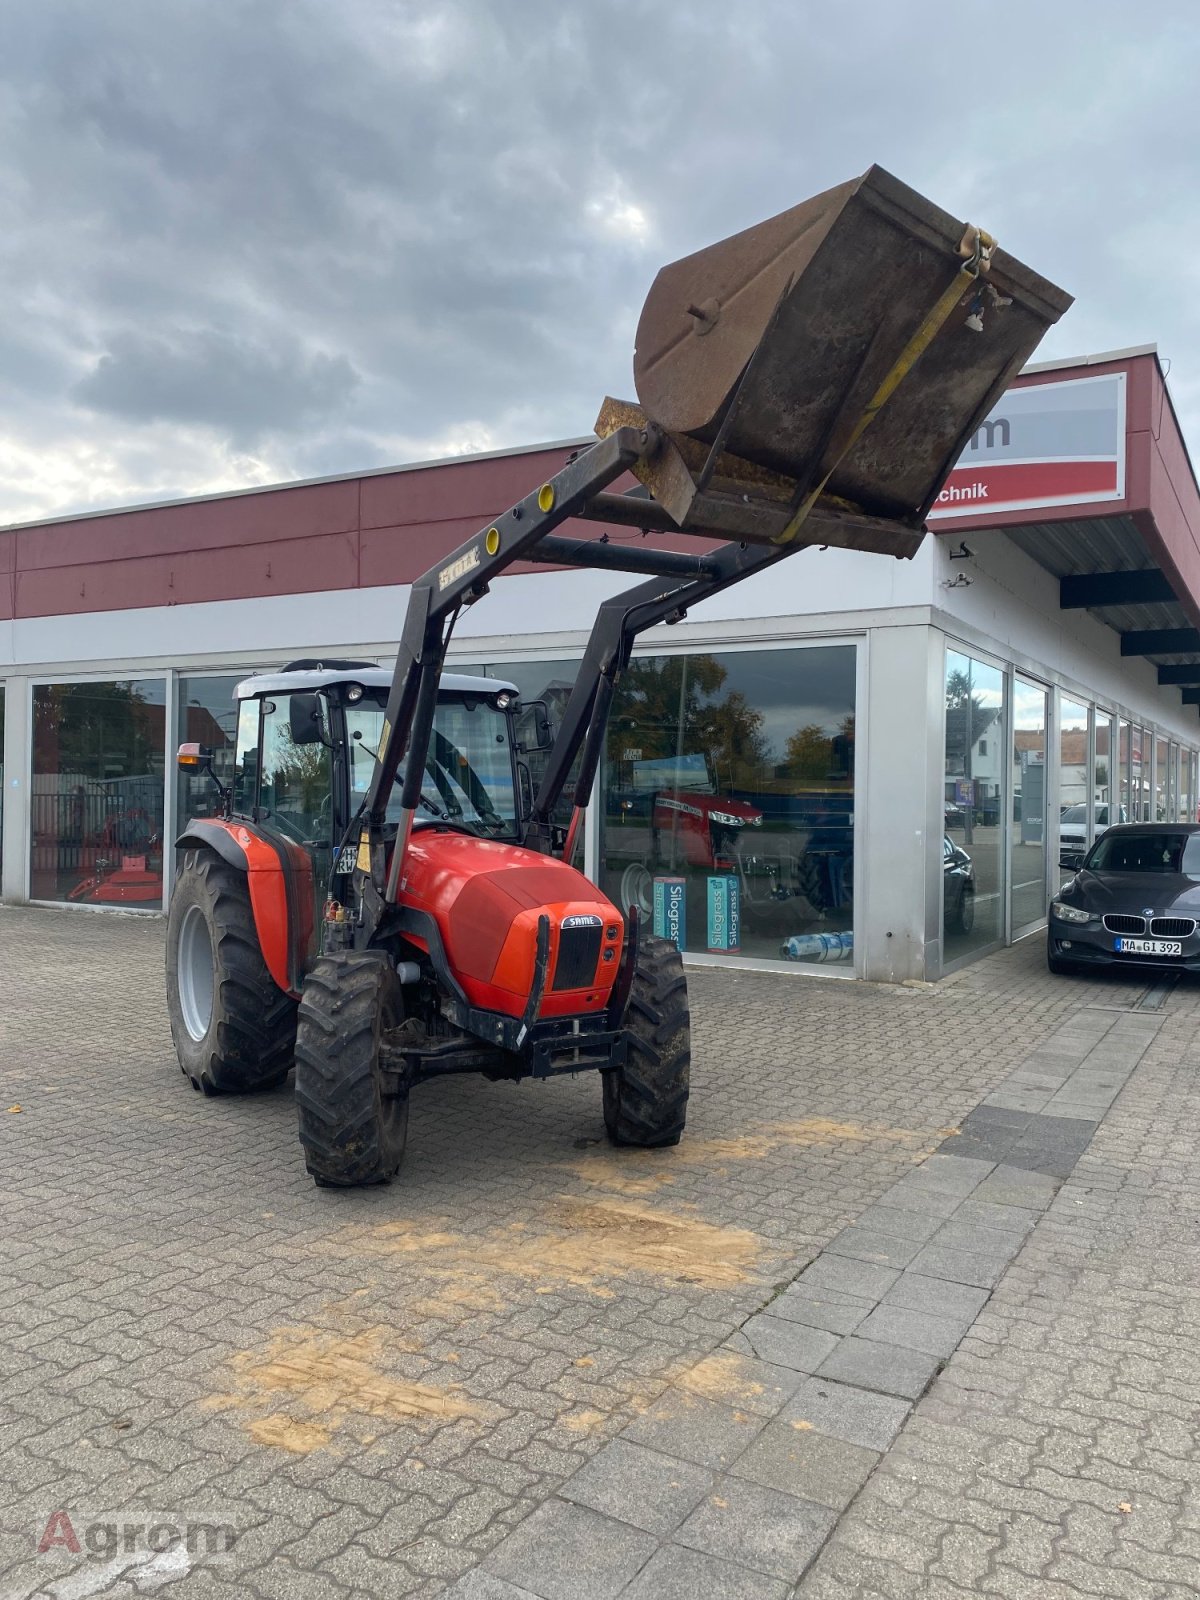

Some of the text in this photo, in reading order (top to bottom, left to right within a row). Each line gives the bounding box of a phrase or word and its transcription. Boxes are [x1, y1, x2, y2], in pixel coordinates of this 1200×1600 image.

[936, 482, 989, 502] chnik
[569, 916, 595, 926] SAME
[711, 890, 725, 946] Silograss
[729, 890, 739, 946] Silograss
[1121, 940, 1136, 951] MA
[1143, 941, 1157, 952] GI
[1159, 942, 1180, 954] 392
